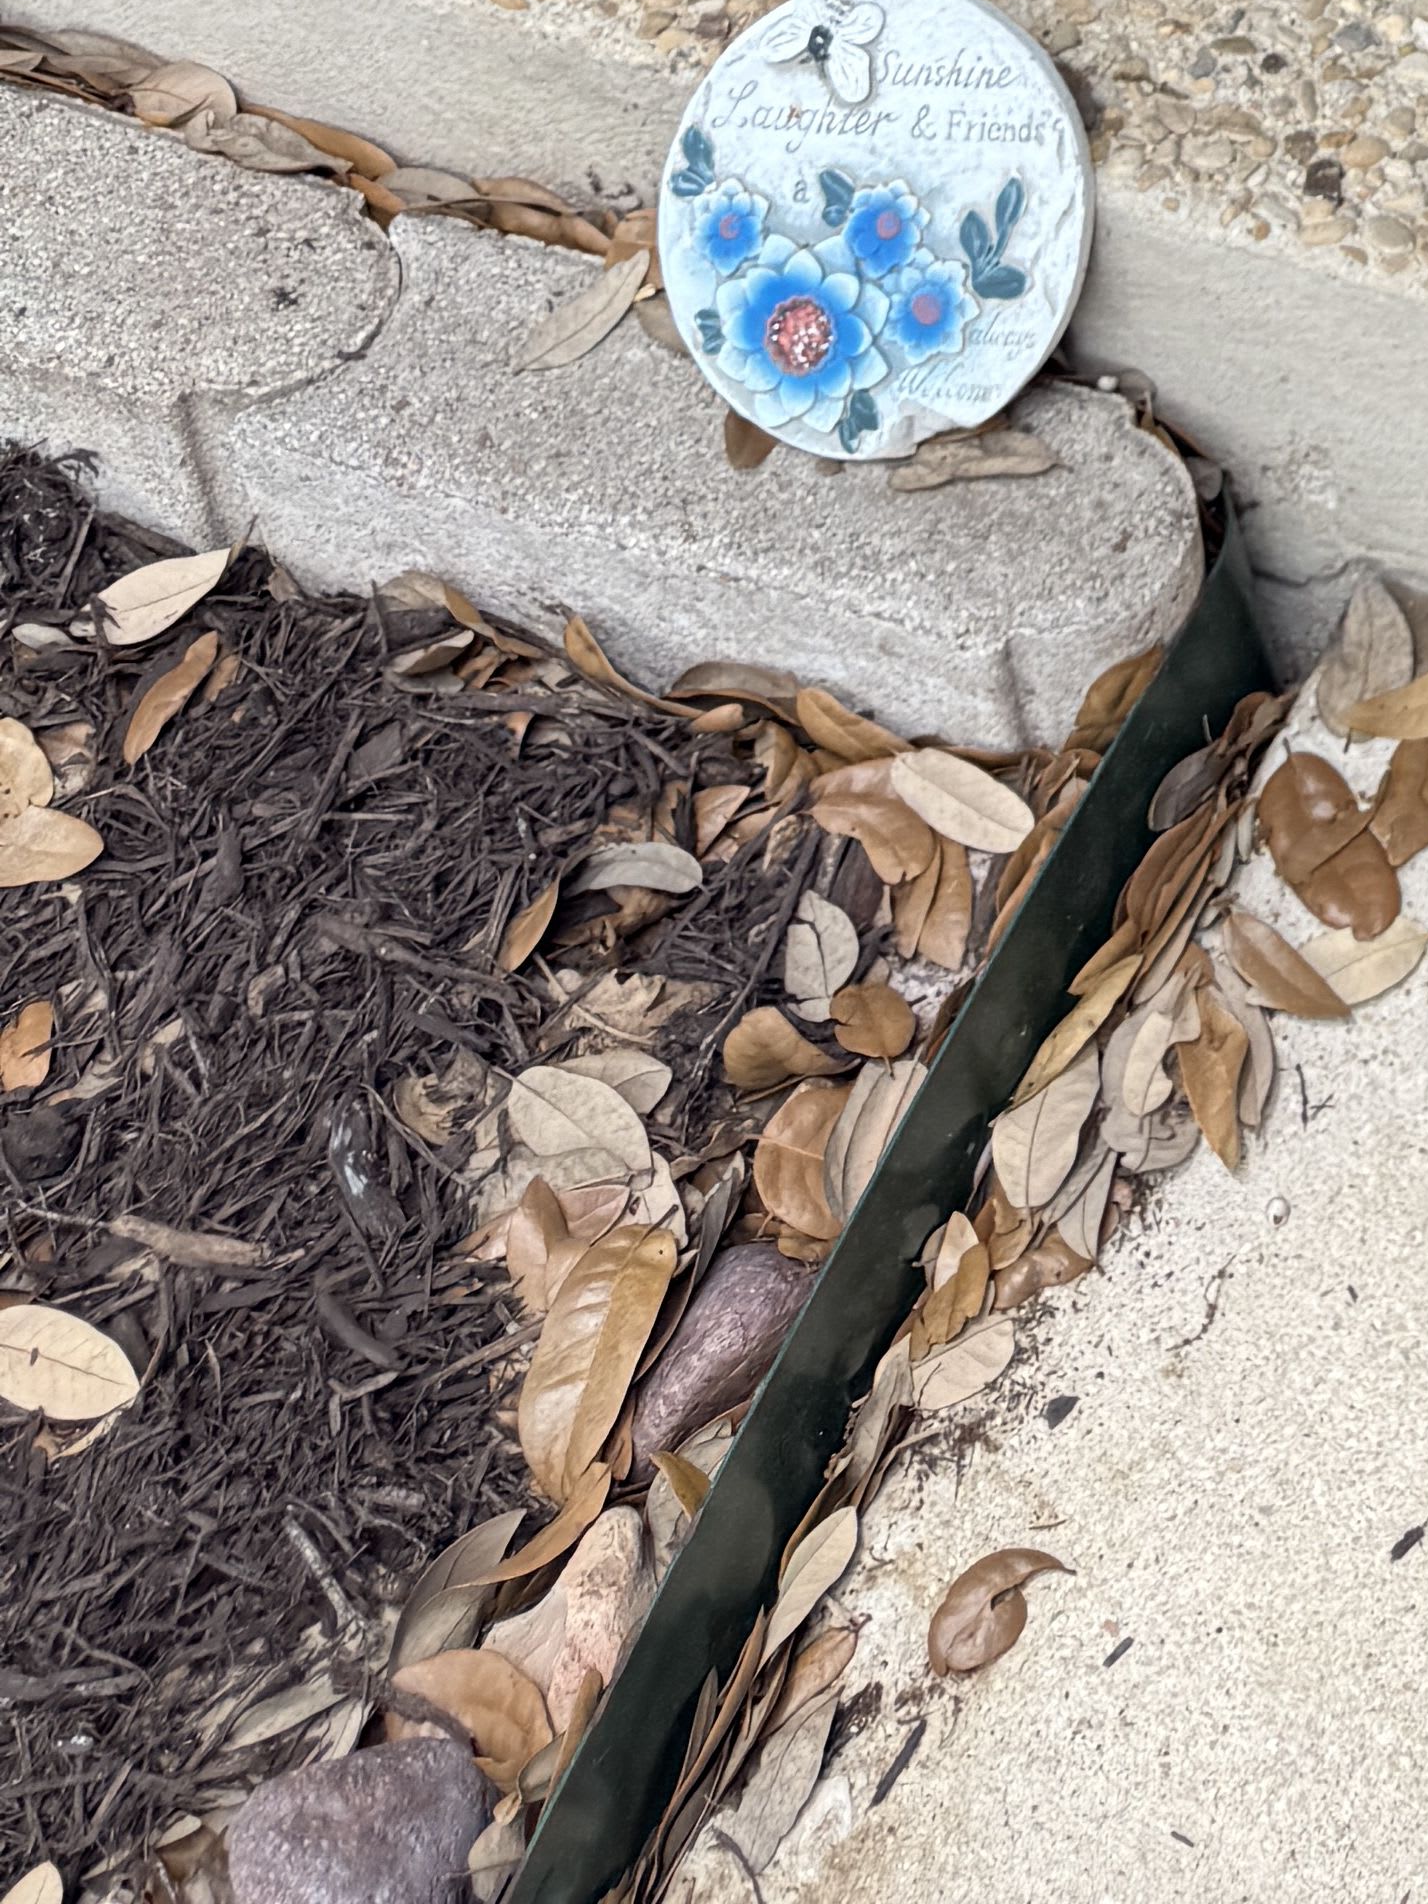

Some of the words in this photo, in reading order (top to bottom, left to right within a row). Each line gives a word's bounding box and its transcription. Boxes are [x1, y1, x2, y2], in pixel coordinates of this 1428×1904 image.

[878, 47, 1016, 89] Sunshine
[711, 79, 899, 153] Laughter
[911, 104, 937, 141] &
[945, 107, 1047, 146] Friends
[968, 310, 1036, 361] always
